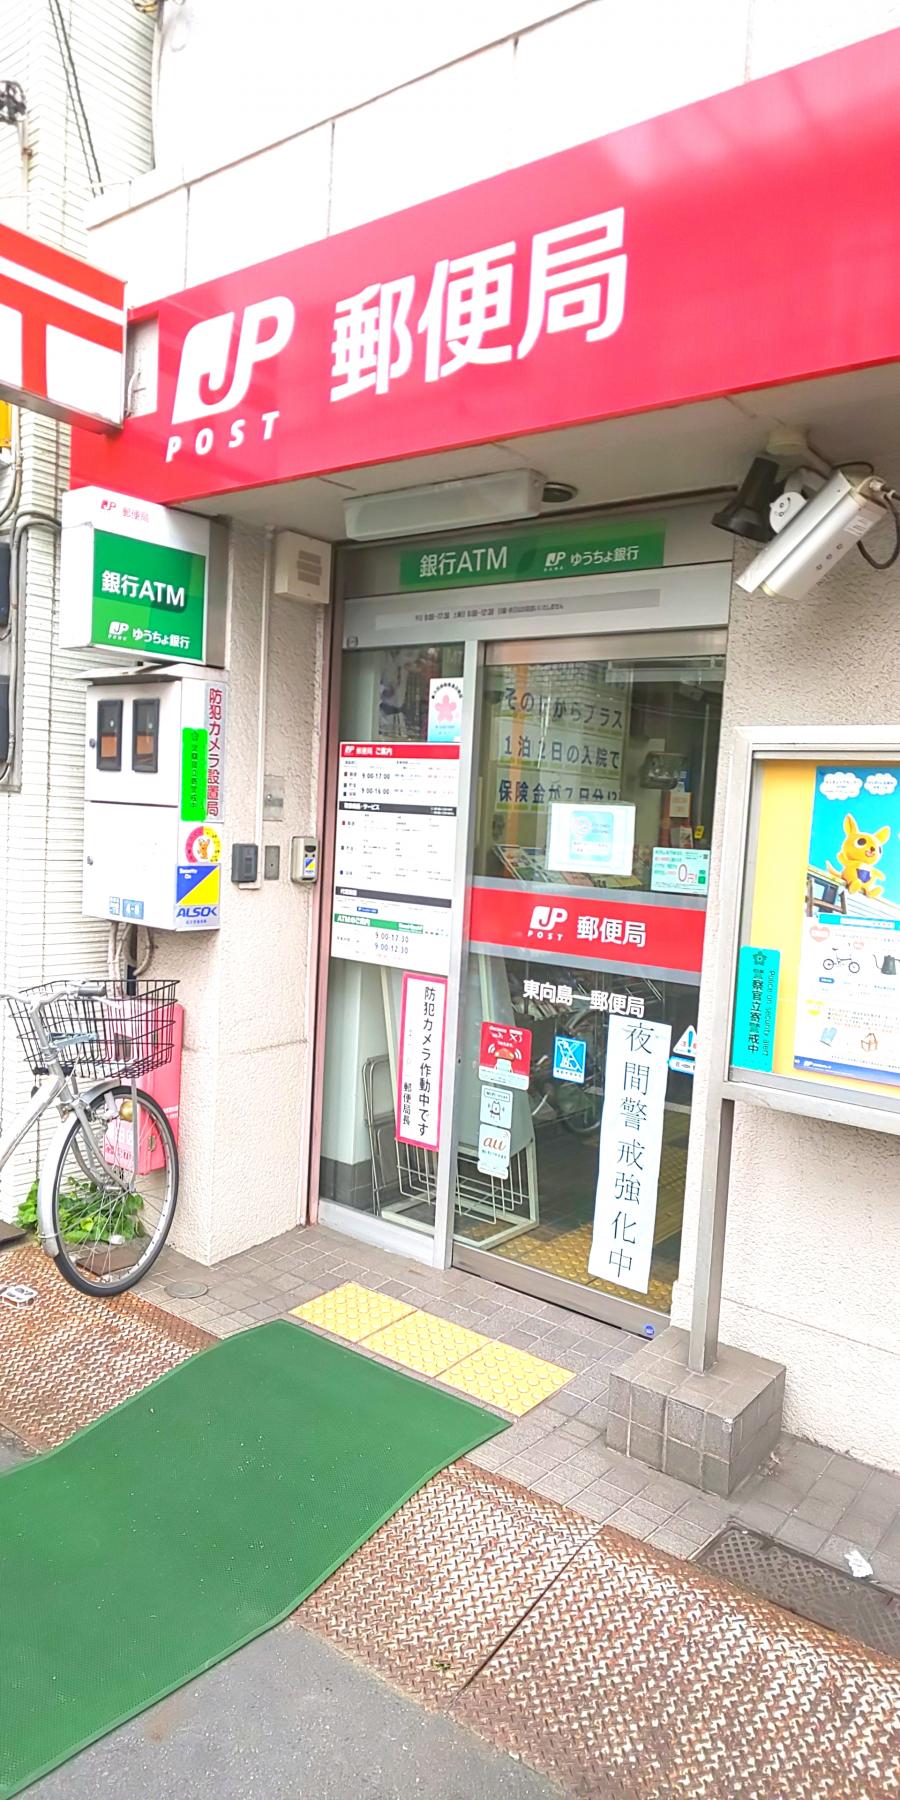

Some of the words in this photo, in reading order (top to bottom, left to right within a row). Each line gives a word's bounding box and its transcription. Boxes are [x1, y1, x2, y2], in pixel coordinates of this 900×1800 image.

[330, 207, 627, 402] 郵便局
[165, 411, 281, 463] POST
[419, 546, 508, 578] 銀行ATM
[570, 545, 639, 567] ゆうちょ銀行
[102, 570, 185, 608] 銀行ATM
[132, 628, 190, 650] ゆうちょ銀行
[207, 687, 222, 817] 防犯カメラ設置局
[176, 906, 218, 918] ALSOK
[527, 930, 564, 942] POST
[576, 915, 646, 948] 郵便局
[523, 979, 645, 1018] 東向島一郵便局
[418, 986, 436, 1137] 防犯カメラ作動中です
[402, 1082, 412, 1126] 郵便局長
[483, 1136, 507, 1152] au
[608, 1021, 655, 1279] 夜間警戒強化中
